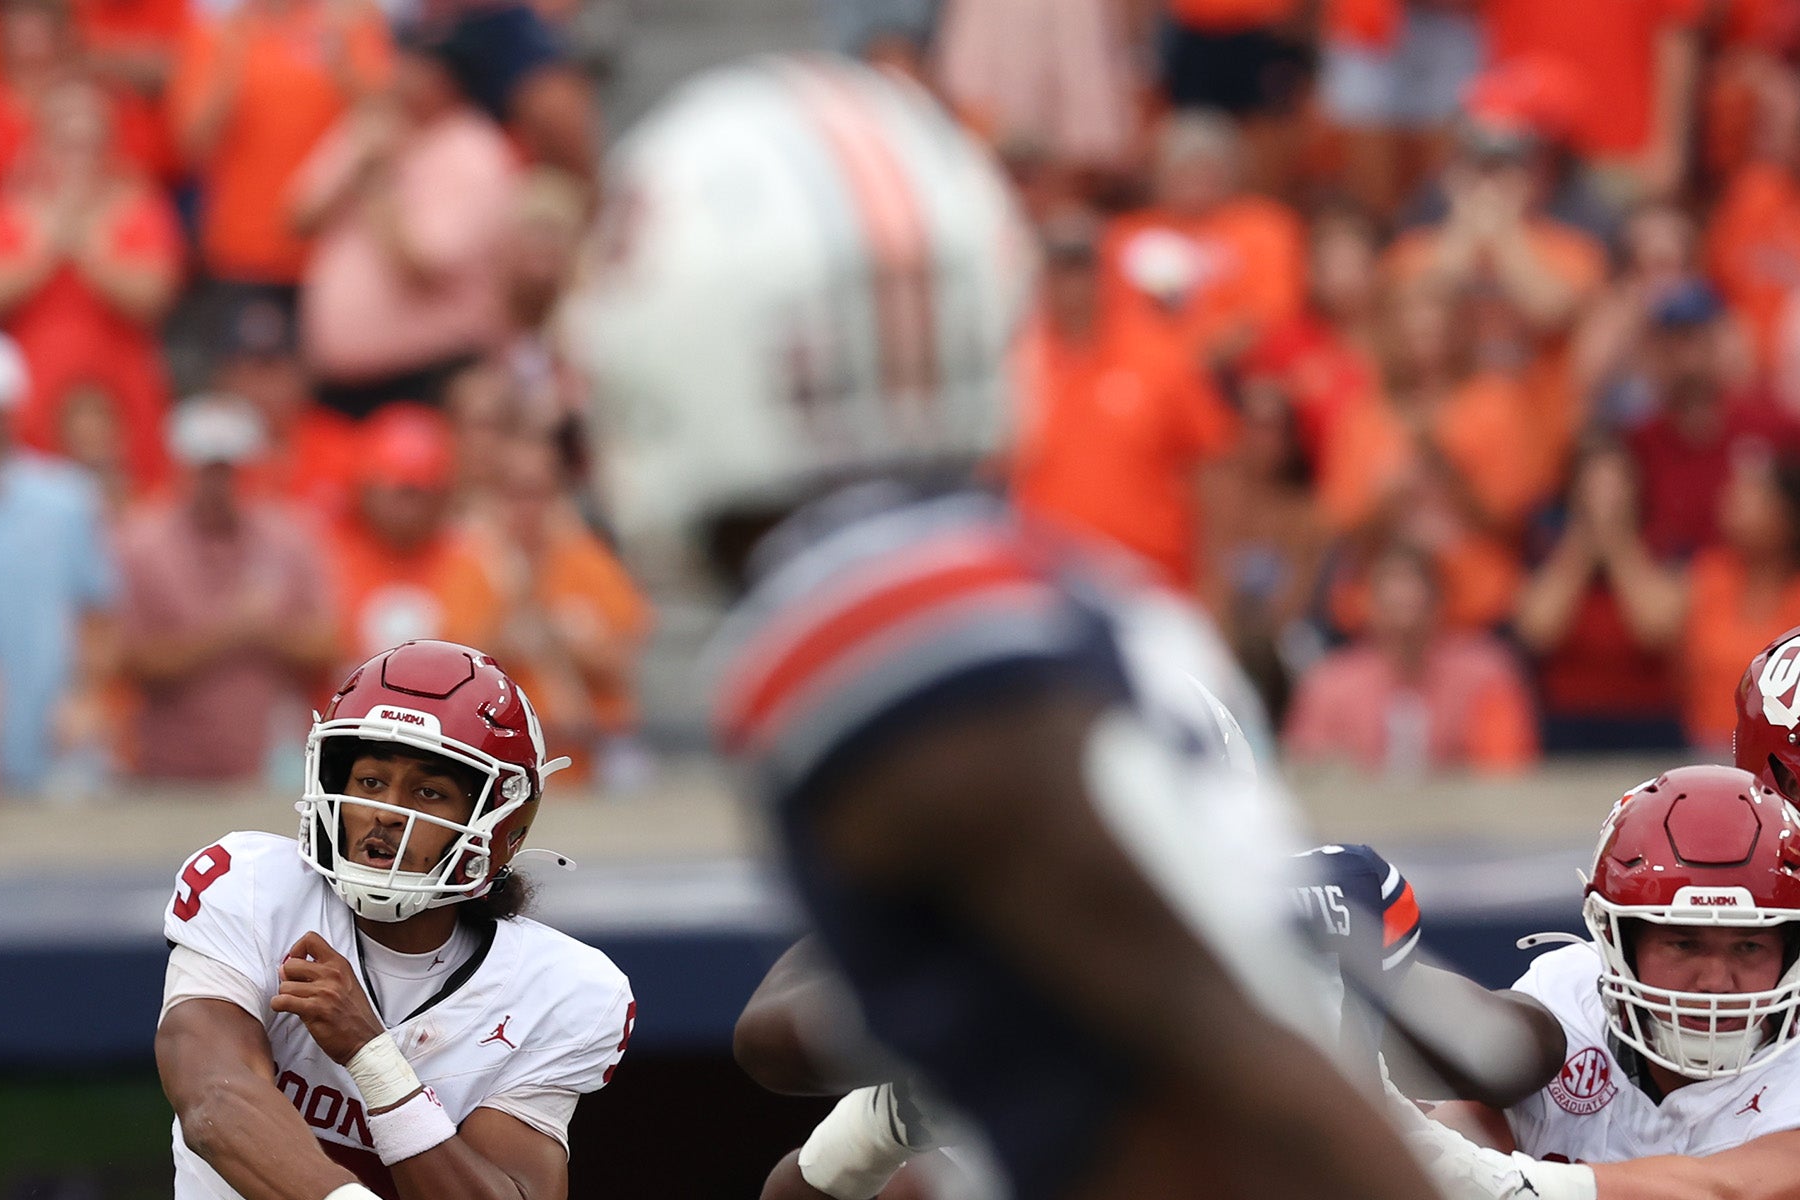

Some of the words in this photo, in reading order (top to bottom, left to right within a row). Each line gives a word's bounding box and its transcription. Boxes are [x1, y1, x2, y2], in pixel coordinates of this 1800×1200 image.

[380, 709, 425, 727] OKLAHOMA
[172, 844, 232, 923] 9
[1689, 895, 1739, 906] OKLAHOMA
[1563, 1049, 1608, 1097] SEC
[1550, 1085, 1607, 1114] GRADUATE
